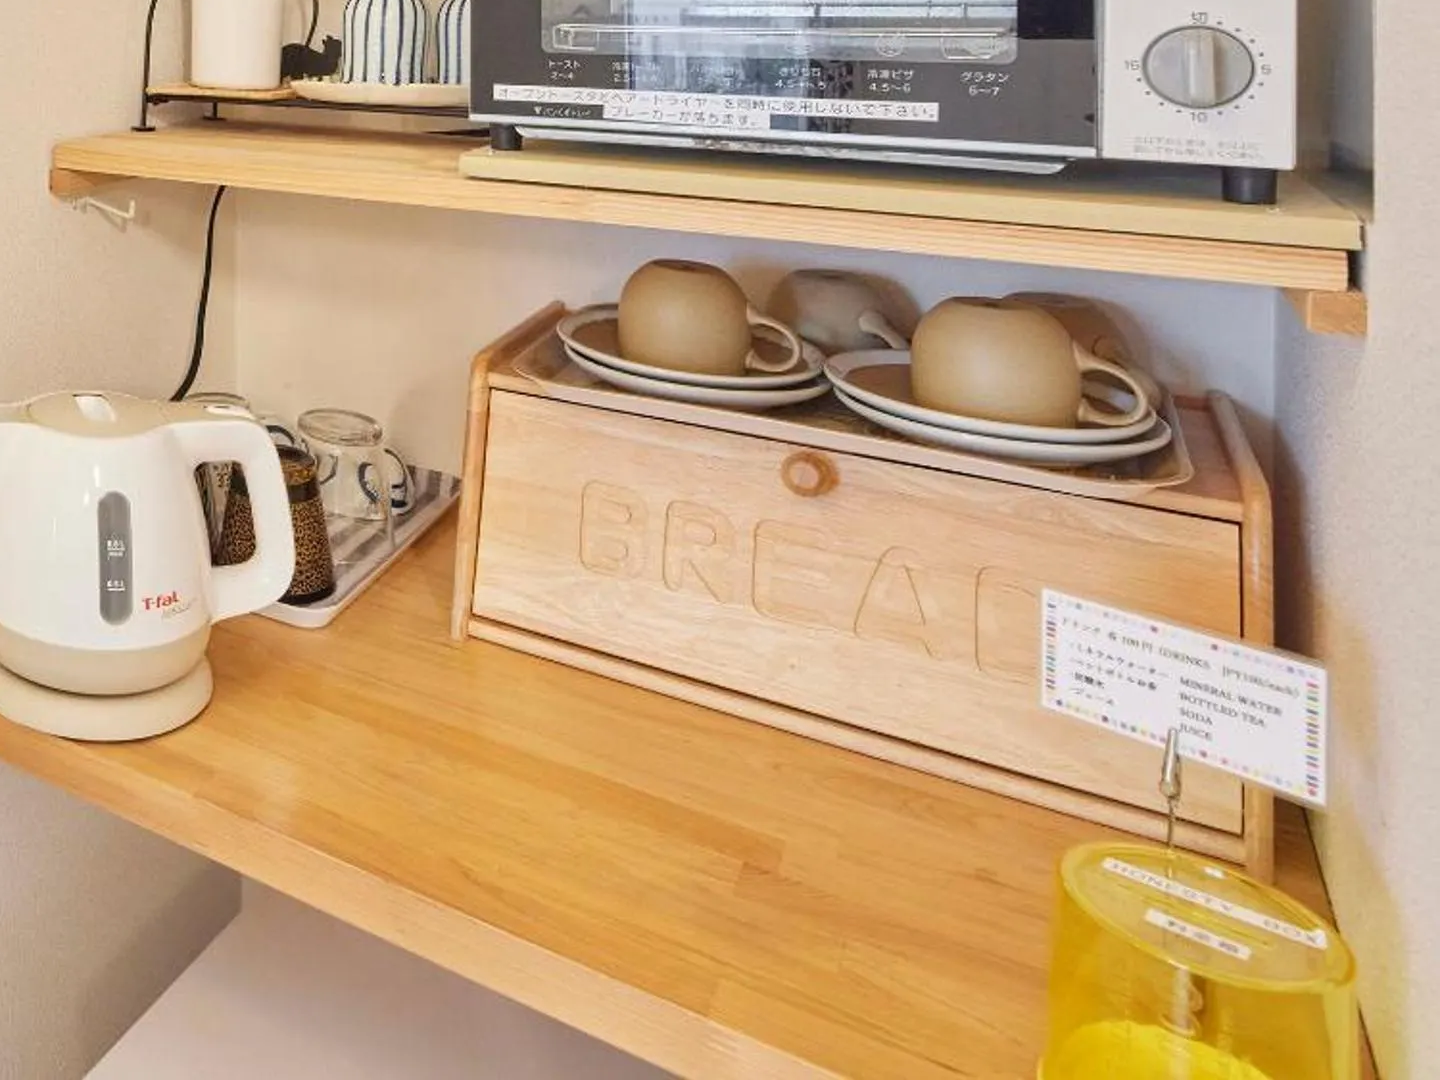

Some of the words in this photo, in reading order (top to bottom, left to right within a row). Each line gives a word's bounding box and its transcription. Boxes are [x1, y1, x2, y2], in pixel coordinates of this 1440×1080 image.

[1180, 676, 1232, 702] MINERAL
[1238, 694, 1283, 717] WATER
[1180, 692, 1238, 719] BOTTLED
[1241, 711, 1265, 728] TEA
[1179, 706, 1213, 726] SODA
[1179, 722, 1212, 741] JUICE
